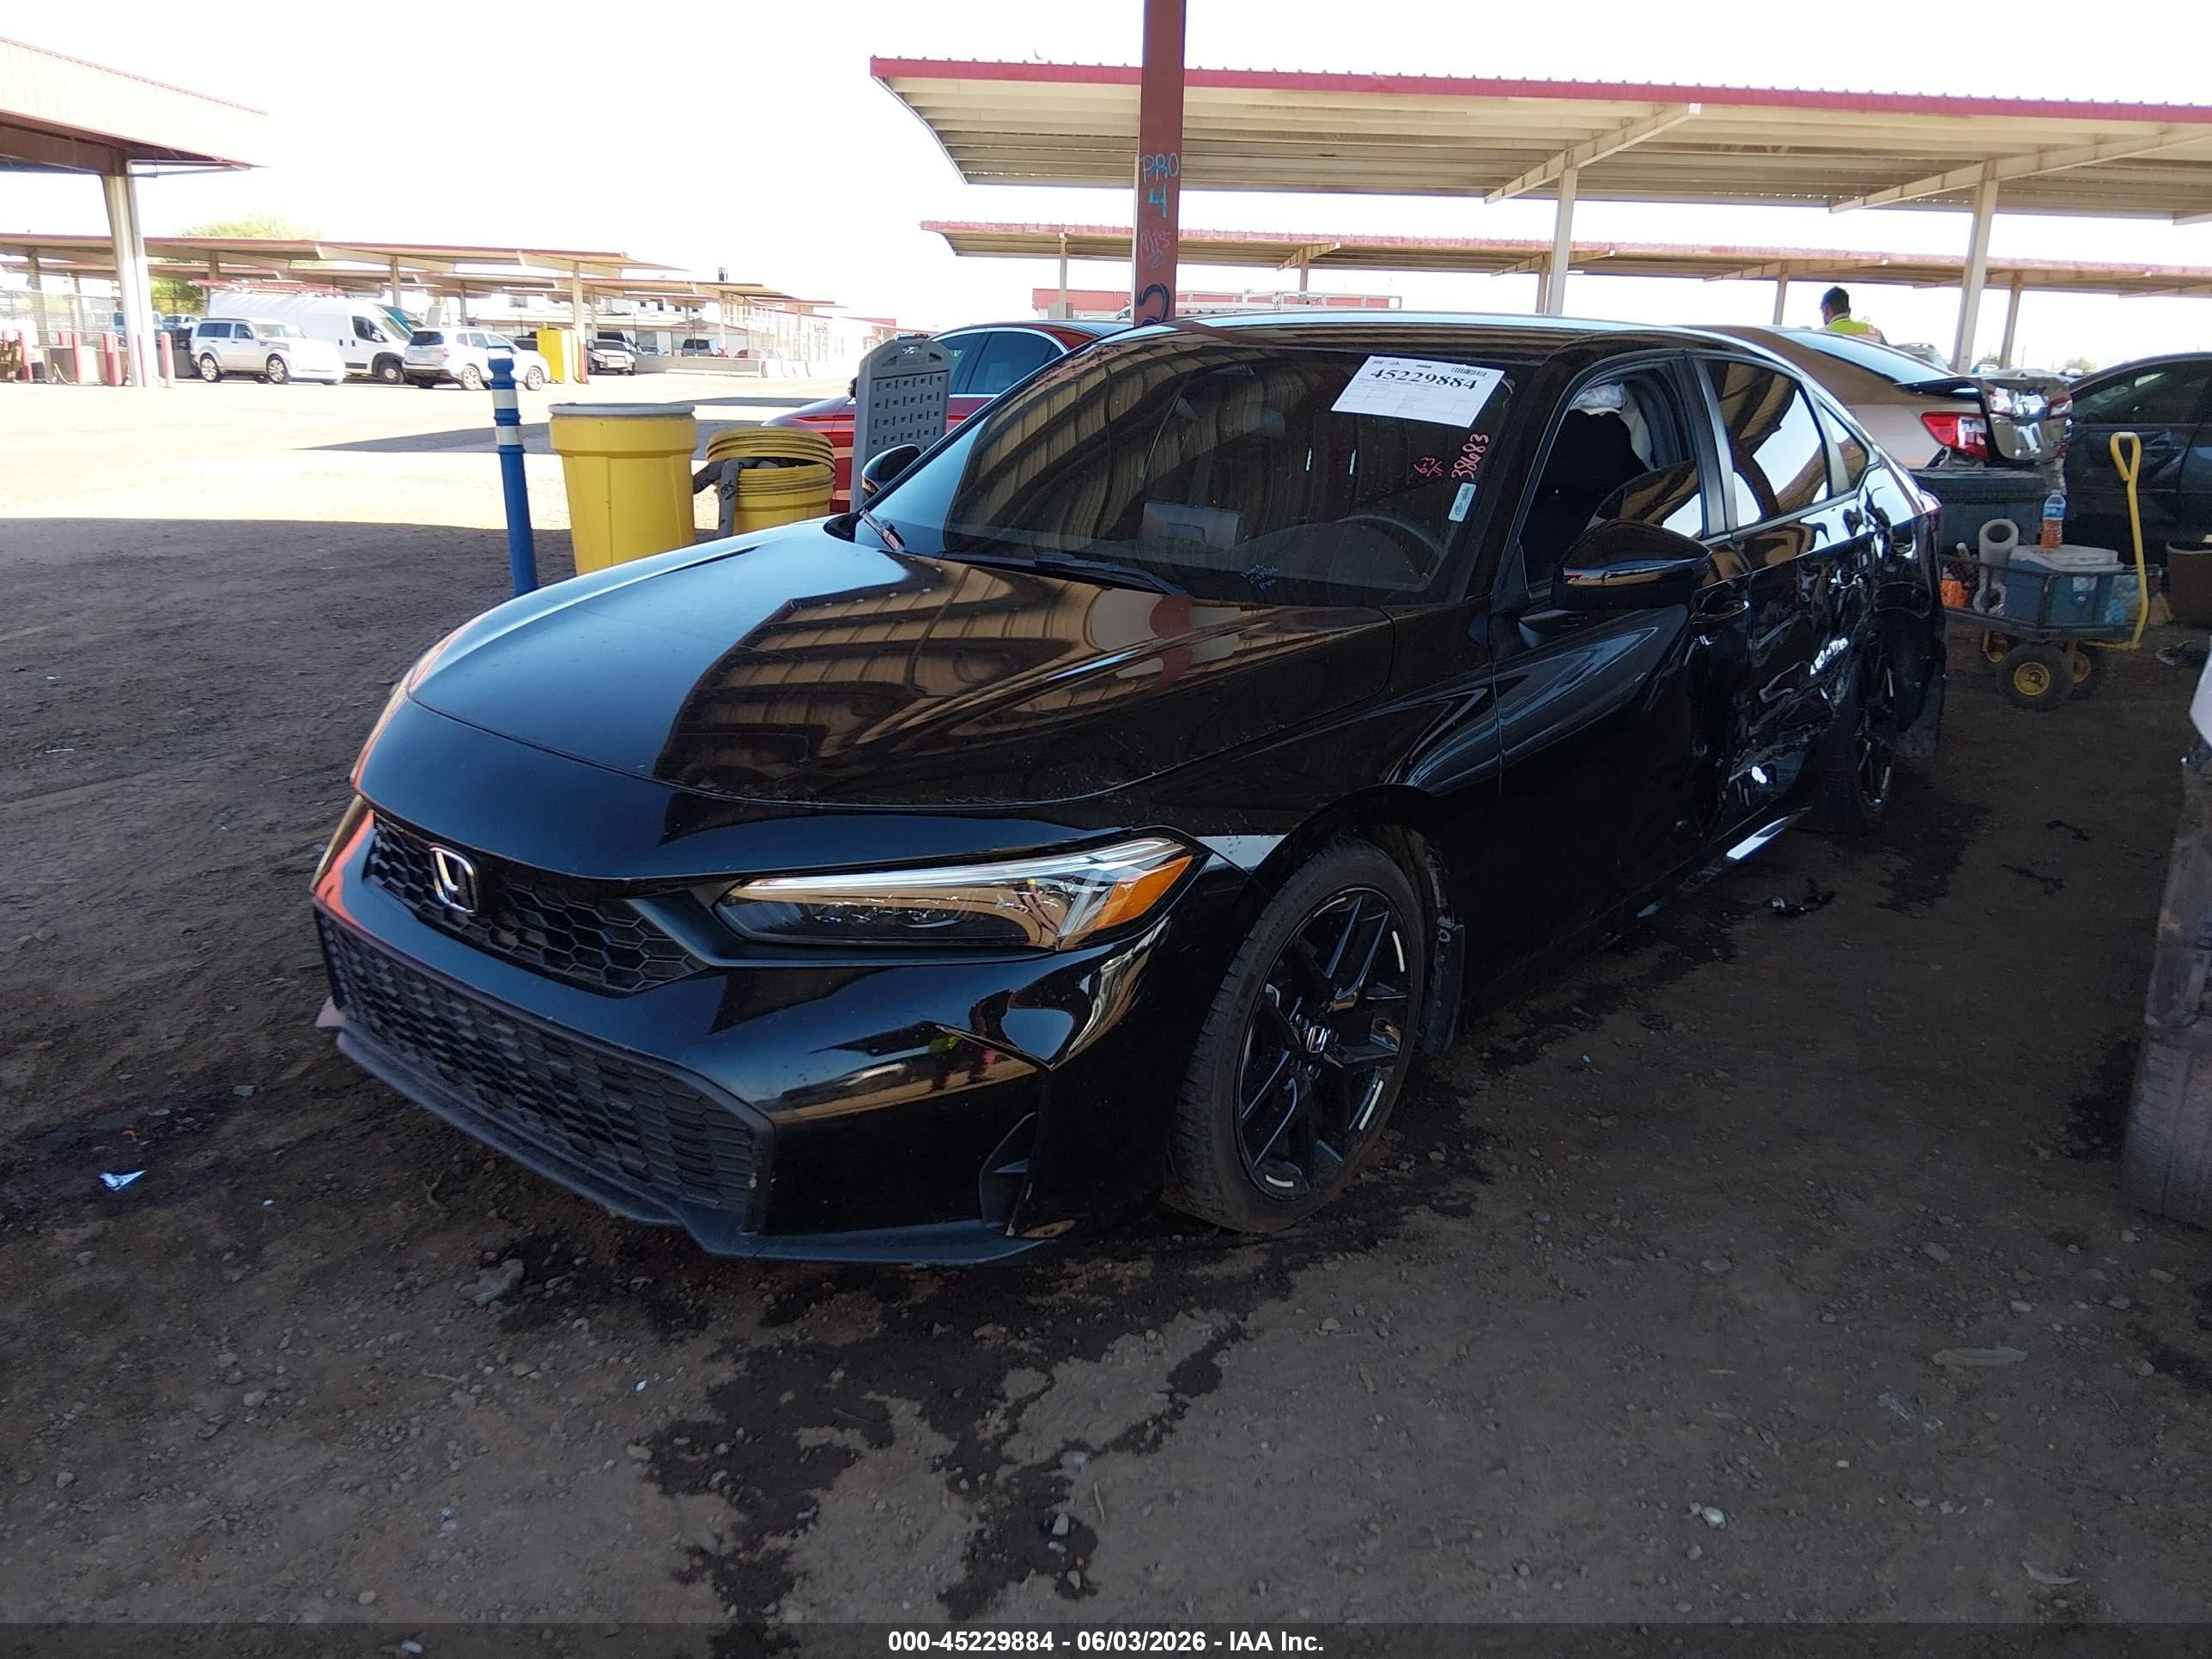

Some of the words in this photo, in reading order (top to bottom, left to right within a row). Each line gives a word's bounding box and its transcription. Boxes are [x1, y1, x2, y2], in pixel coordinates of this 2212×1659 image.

[1148, 184, 1168, 219] 4
[1370, 368, 1478, 390] 45229884
[1451, 434, 1489, 479] 38683
